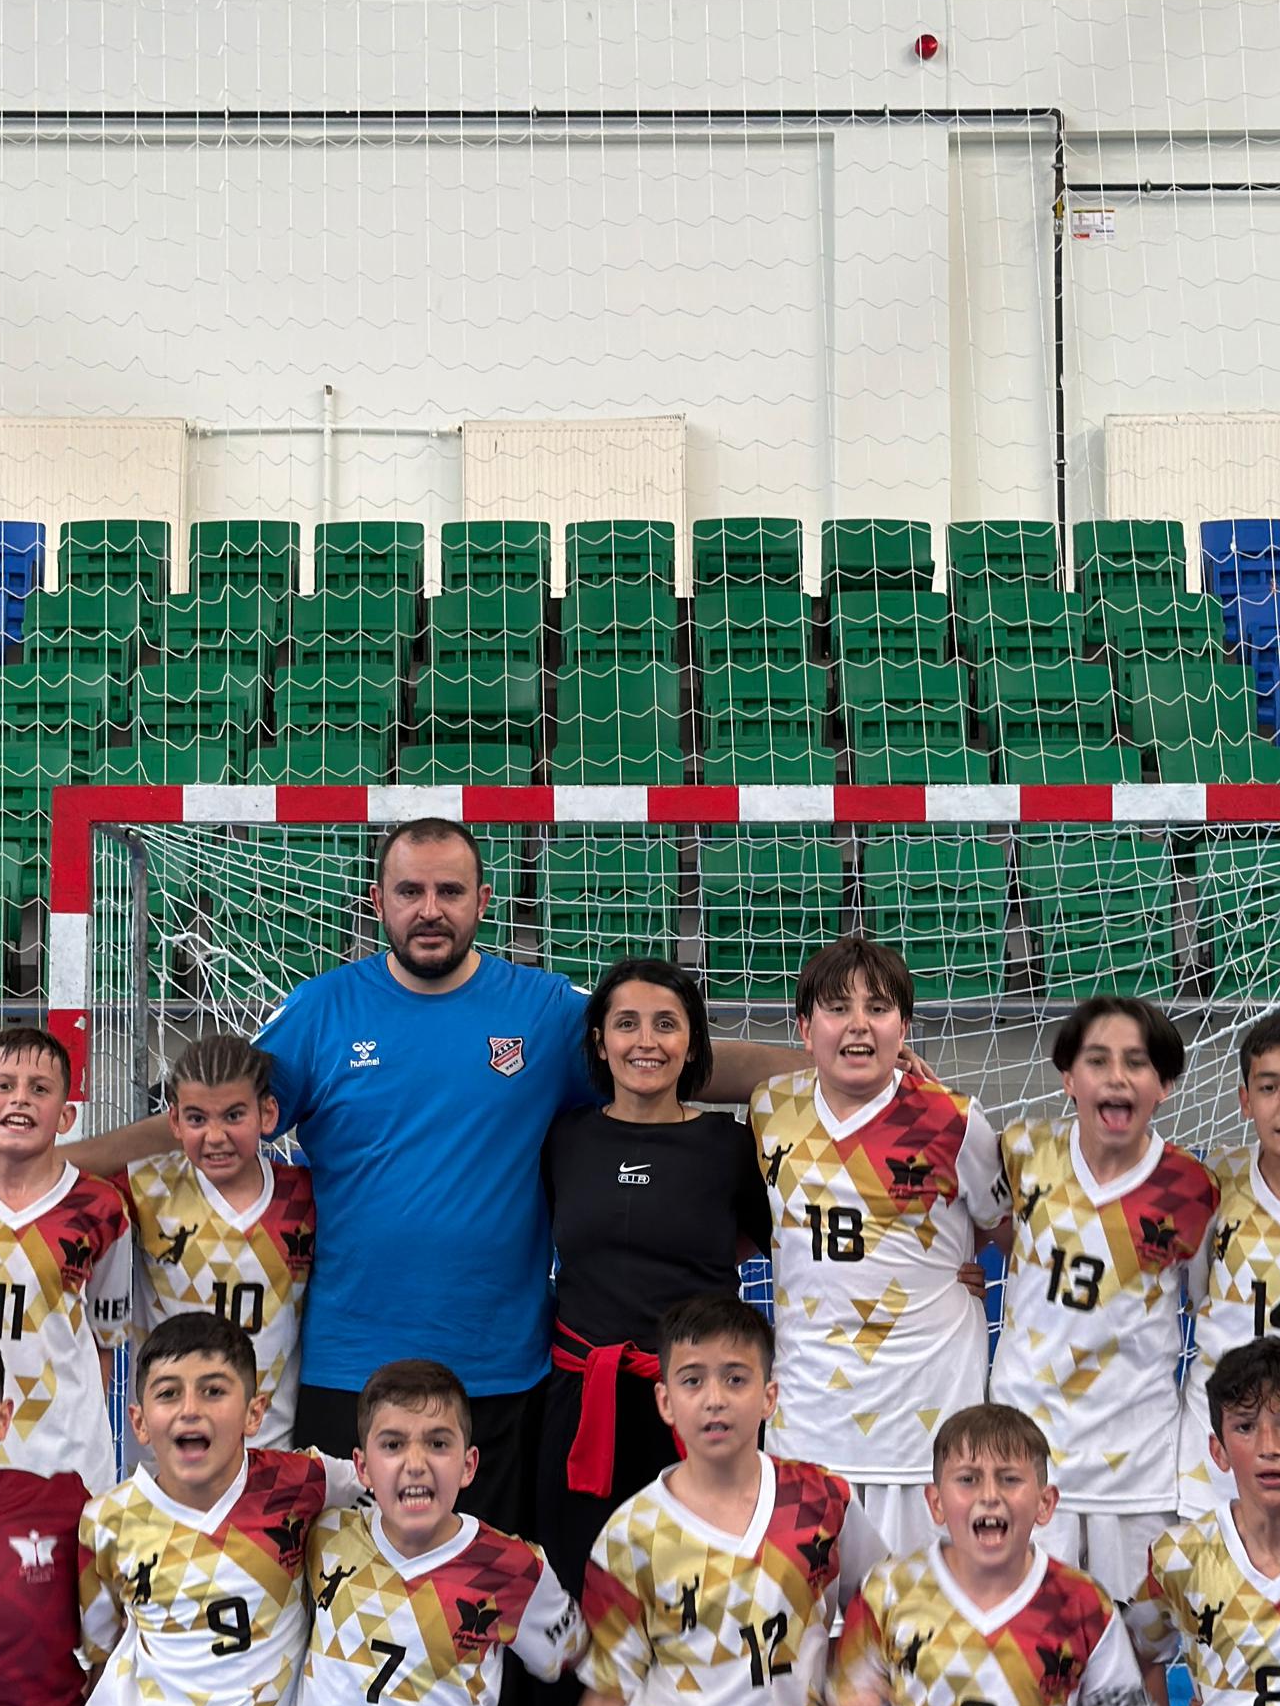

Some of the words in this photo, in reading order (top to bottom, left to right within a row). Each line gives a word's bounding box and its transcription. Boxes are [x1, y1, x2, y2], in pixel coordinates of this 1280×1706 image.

[350, 1057, 380, 1069] hummel
[803, 1203, 865, 1262] 18
[212, 1281, 265, 1335] 10
[1047, 1247, 1106, 1312] 13
[206, 1596, 252, 1657] 9
[738, 1612, 792, 1687] 12
[367, 1639, 407, 1705] 7
